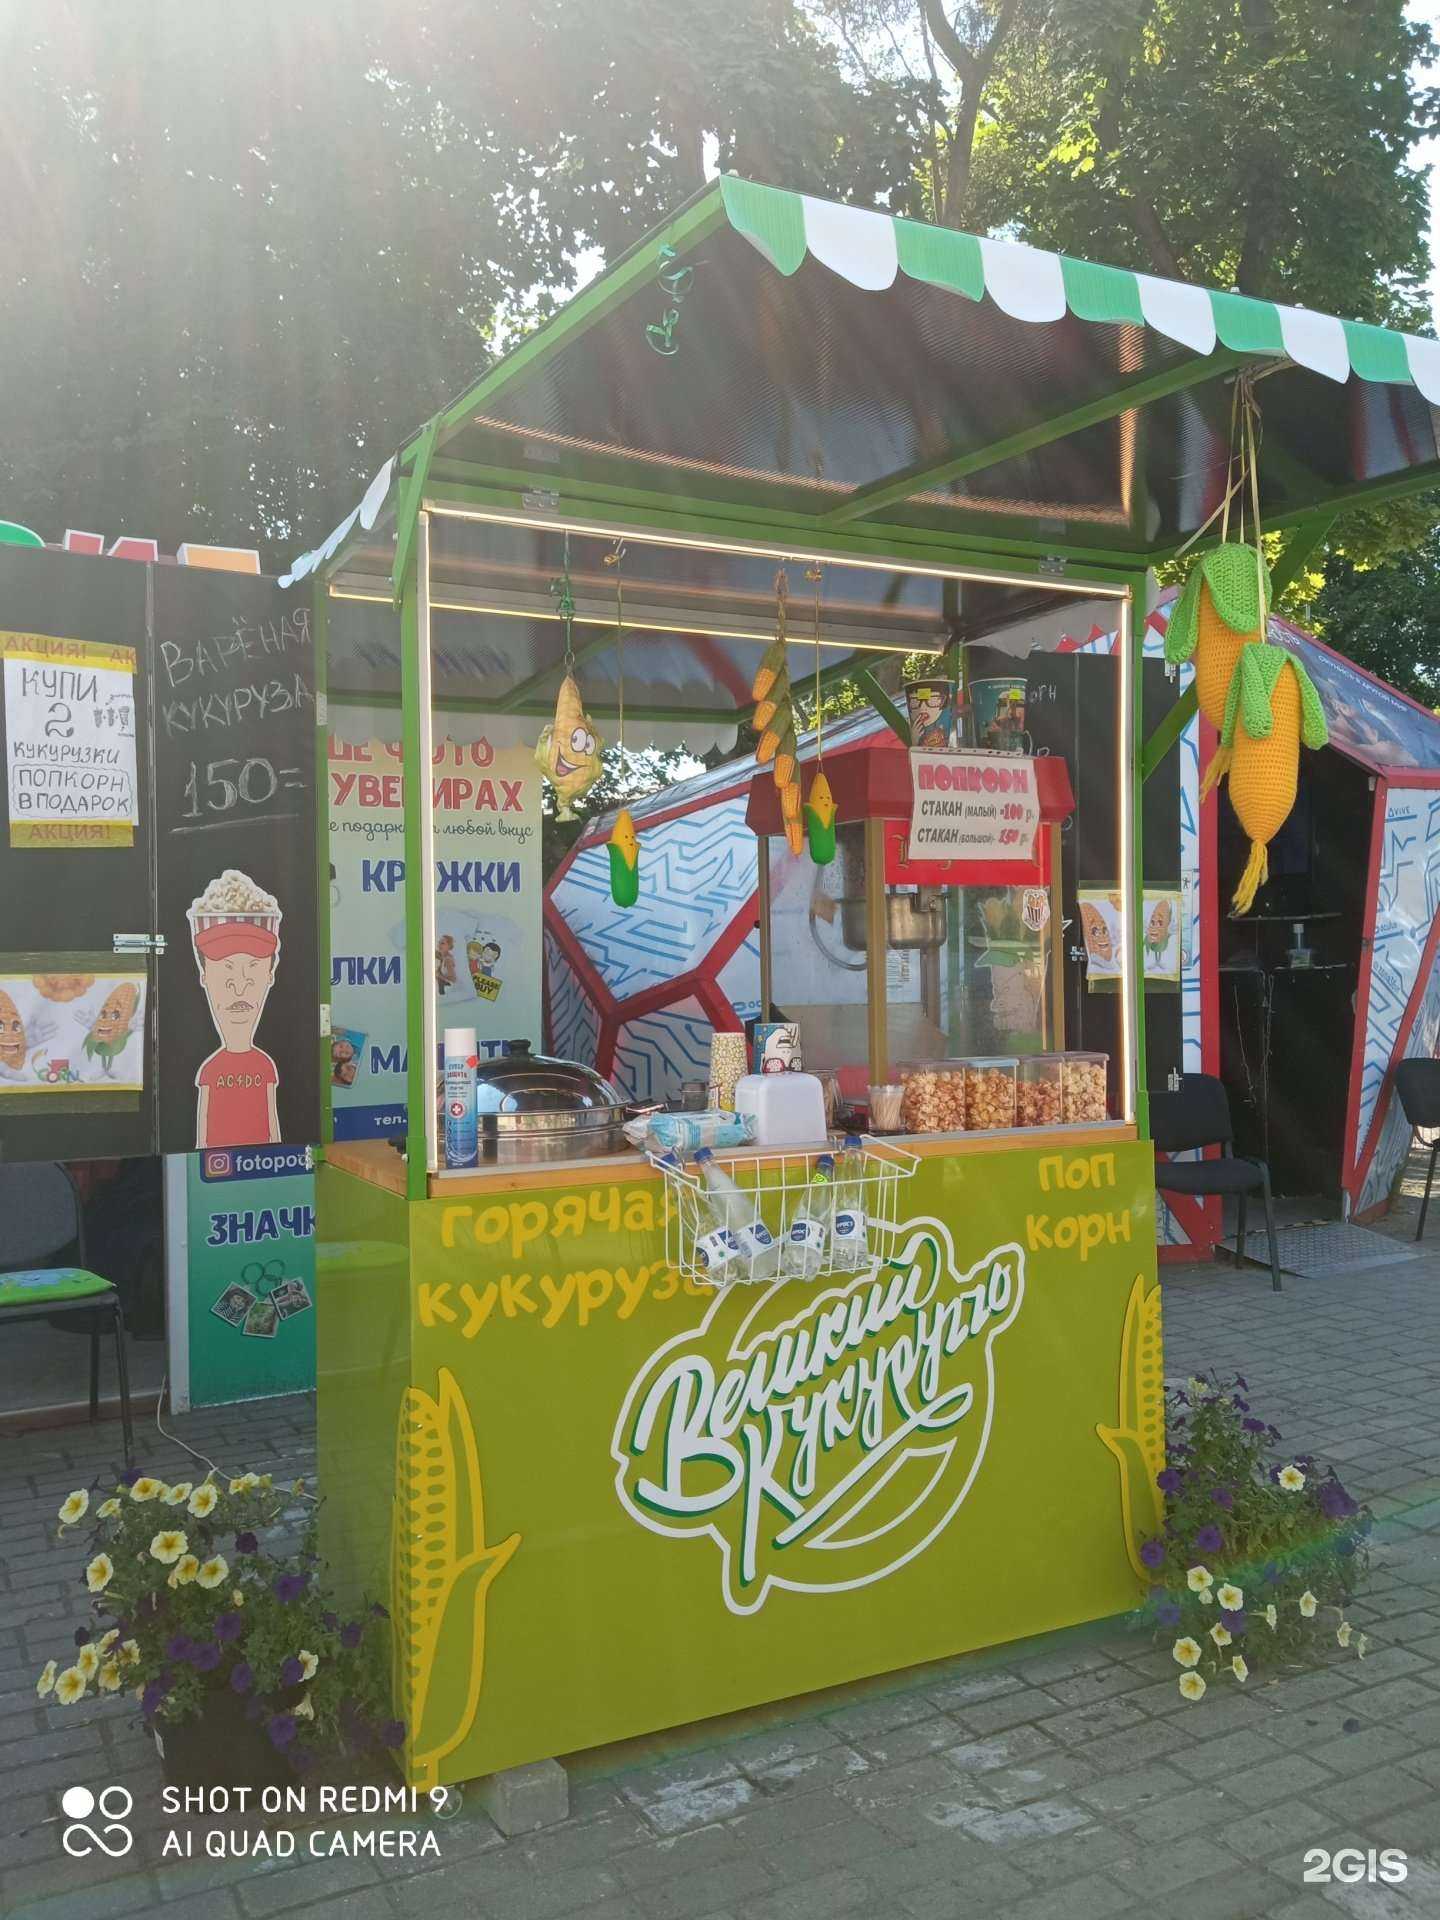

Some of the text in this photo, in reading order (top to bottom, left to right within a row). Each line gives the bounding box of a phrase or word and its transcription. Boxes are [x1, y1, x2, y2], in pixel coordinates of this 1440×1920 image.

[6, 635, 87, 659] АКЦИЯ!
[22, 667, 97, 703] КУПИ
[162, 673, 314, 737] КУКУРУЗА
[45, 702, 75, 738] 2
[13, 741, 120, 764] КУКУРУЗКИ
[18, 768, 125, 793] ПОПКОРН
[917, 763, 1029, 794] ПОПКОРН
[921, 800, 963, 817] СТАКАН
[29, 823, 112, 842] АКЦИЯ!
[443, 817, 496, 838] любой
[497, 817, 534, 845] вкус
[917, 827, 959, 844] СТАКАН
[361, 859, 521, 893] КРЖКИ
